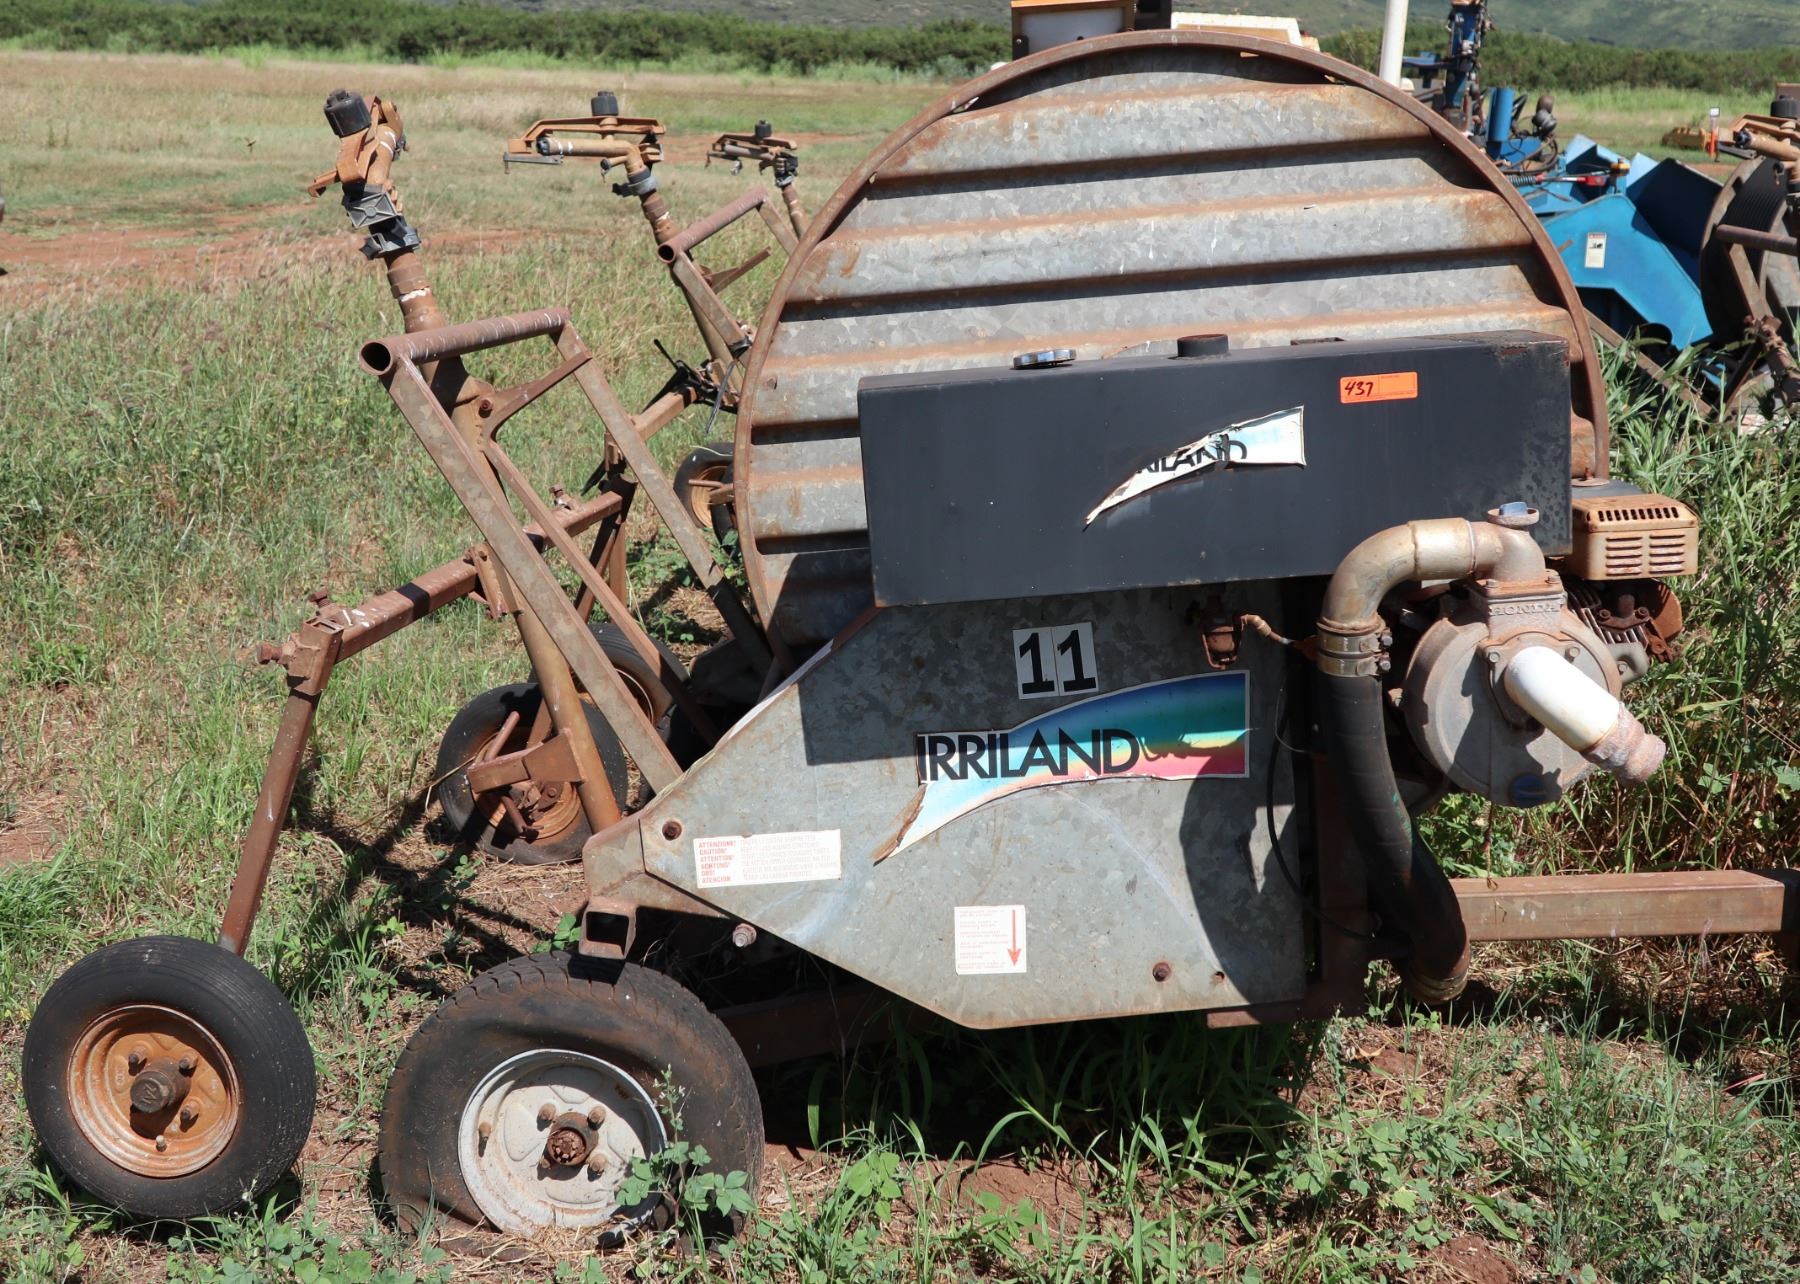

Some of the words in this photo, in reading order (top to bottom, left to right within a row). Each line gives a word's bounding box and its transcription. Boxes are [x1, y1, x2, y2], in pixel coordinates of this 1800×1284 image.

[1344, 381, 1374, 397] 437
[1018, 629, 1097, 694] 11
[917, 727, 1141, 781] IRRILAND
